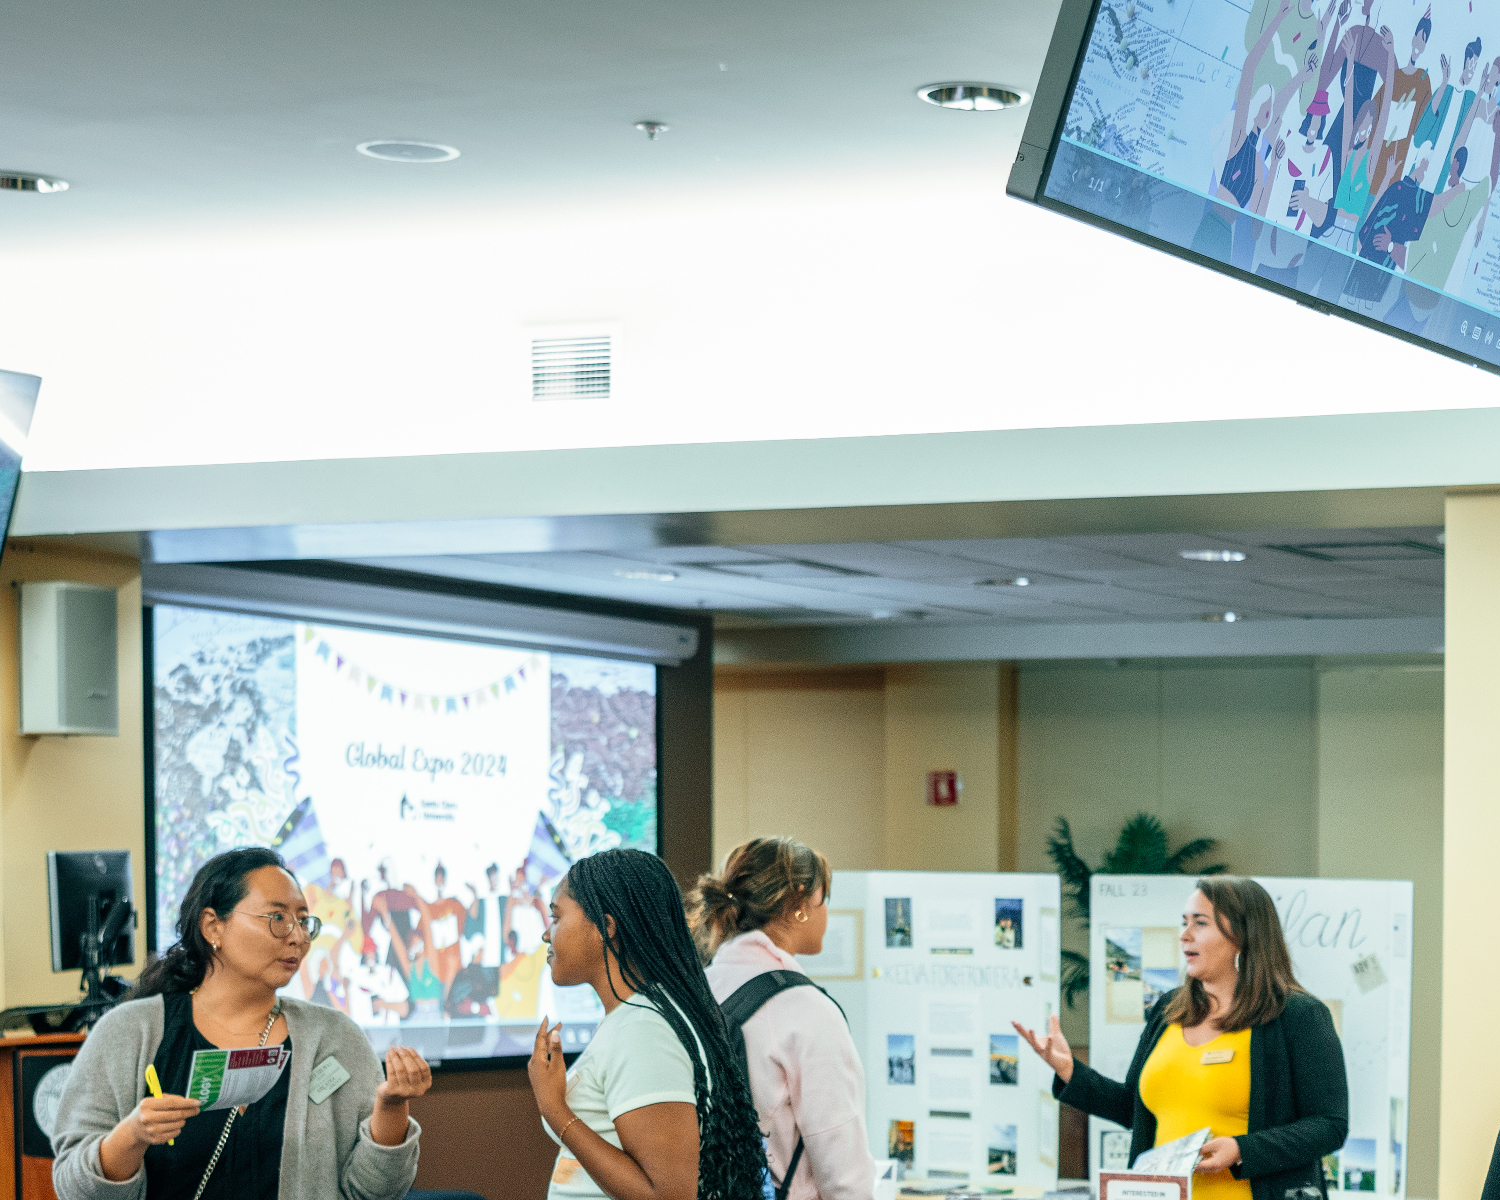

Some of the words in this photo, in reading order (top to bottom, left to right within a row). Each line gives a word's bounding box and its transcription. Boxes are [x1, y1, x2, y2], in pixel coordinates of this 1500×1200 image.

[346, 742, 405, 770] Global
[412, 748, 454, 783] Expo
[460, 752, 507, 777] 2024
